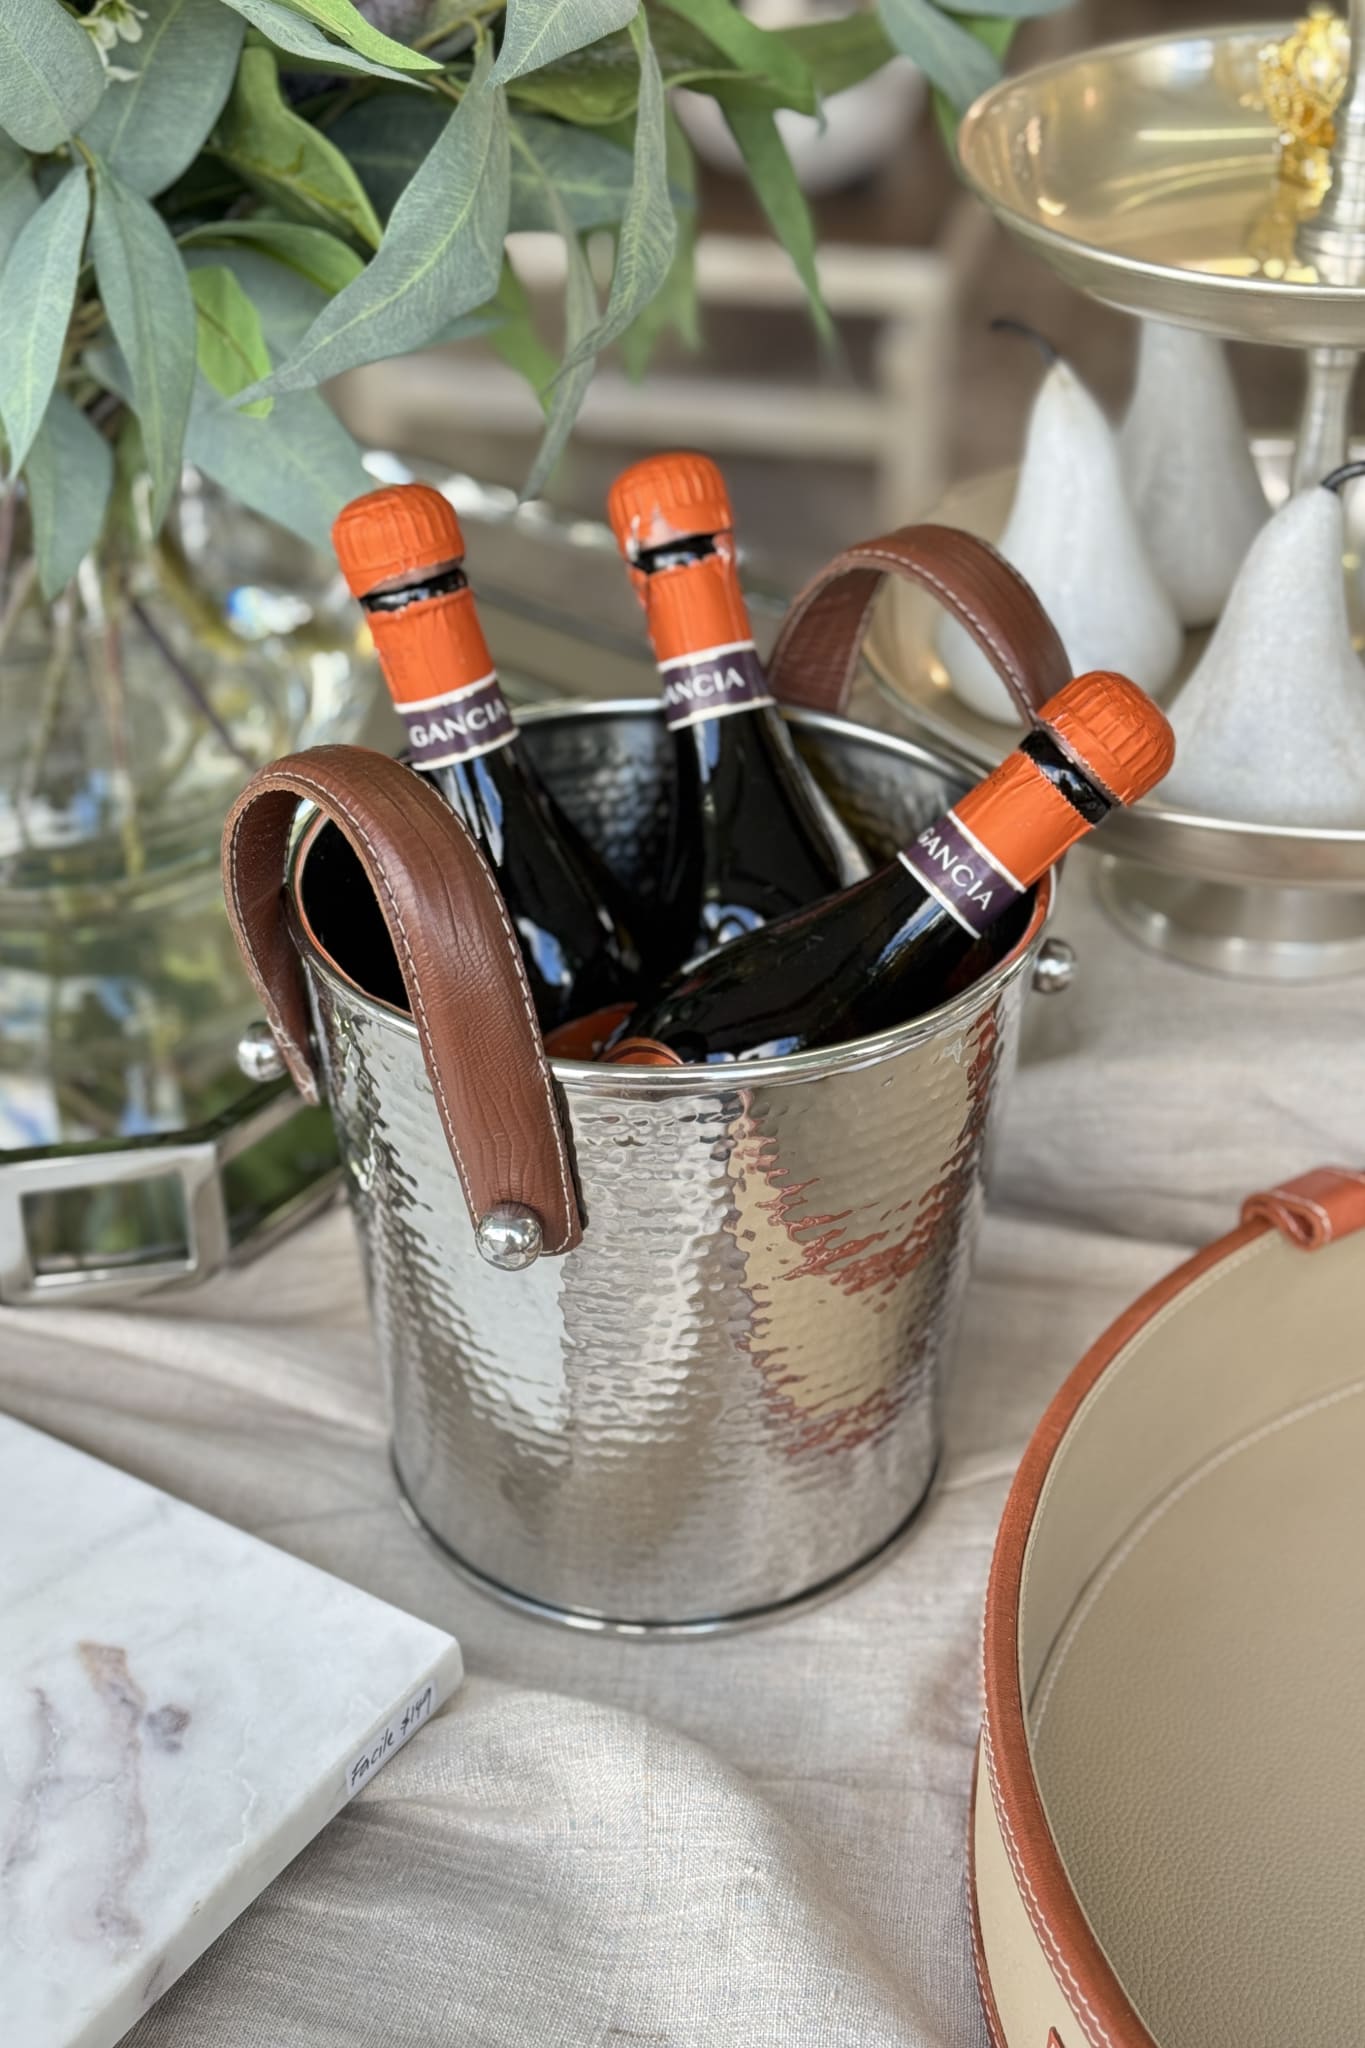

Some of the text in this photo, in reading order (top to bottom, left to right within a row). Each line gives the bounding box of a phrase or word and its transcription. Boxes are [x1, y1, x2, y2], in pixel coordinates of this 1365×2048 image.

[662, 667, 746, 705] ANCIA
[409, 698, 507, 748] GANCIA
[917, 827, 993, 911] GANCIA
[351, 1728, 394, 1786] Facile
